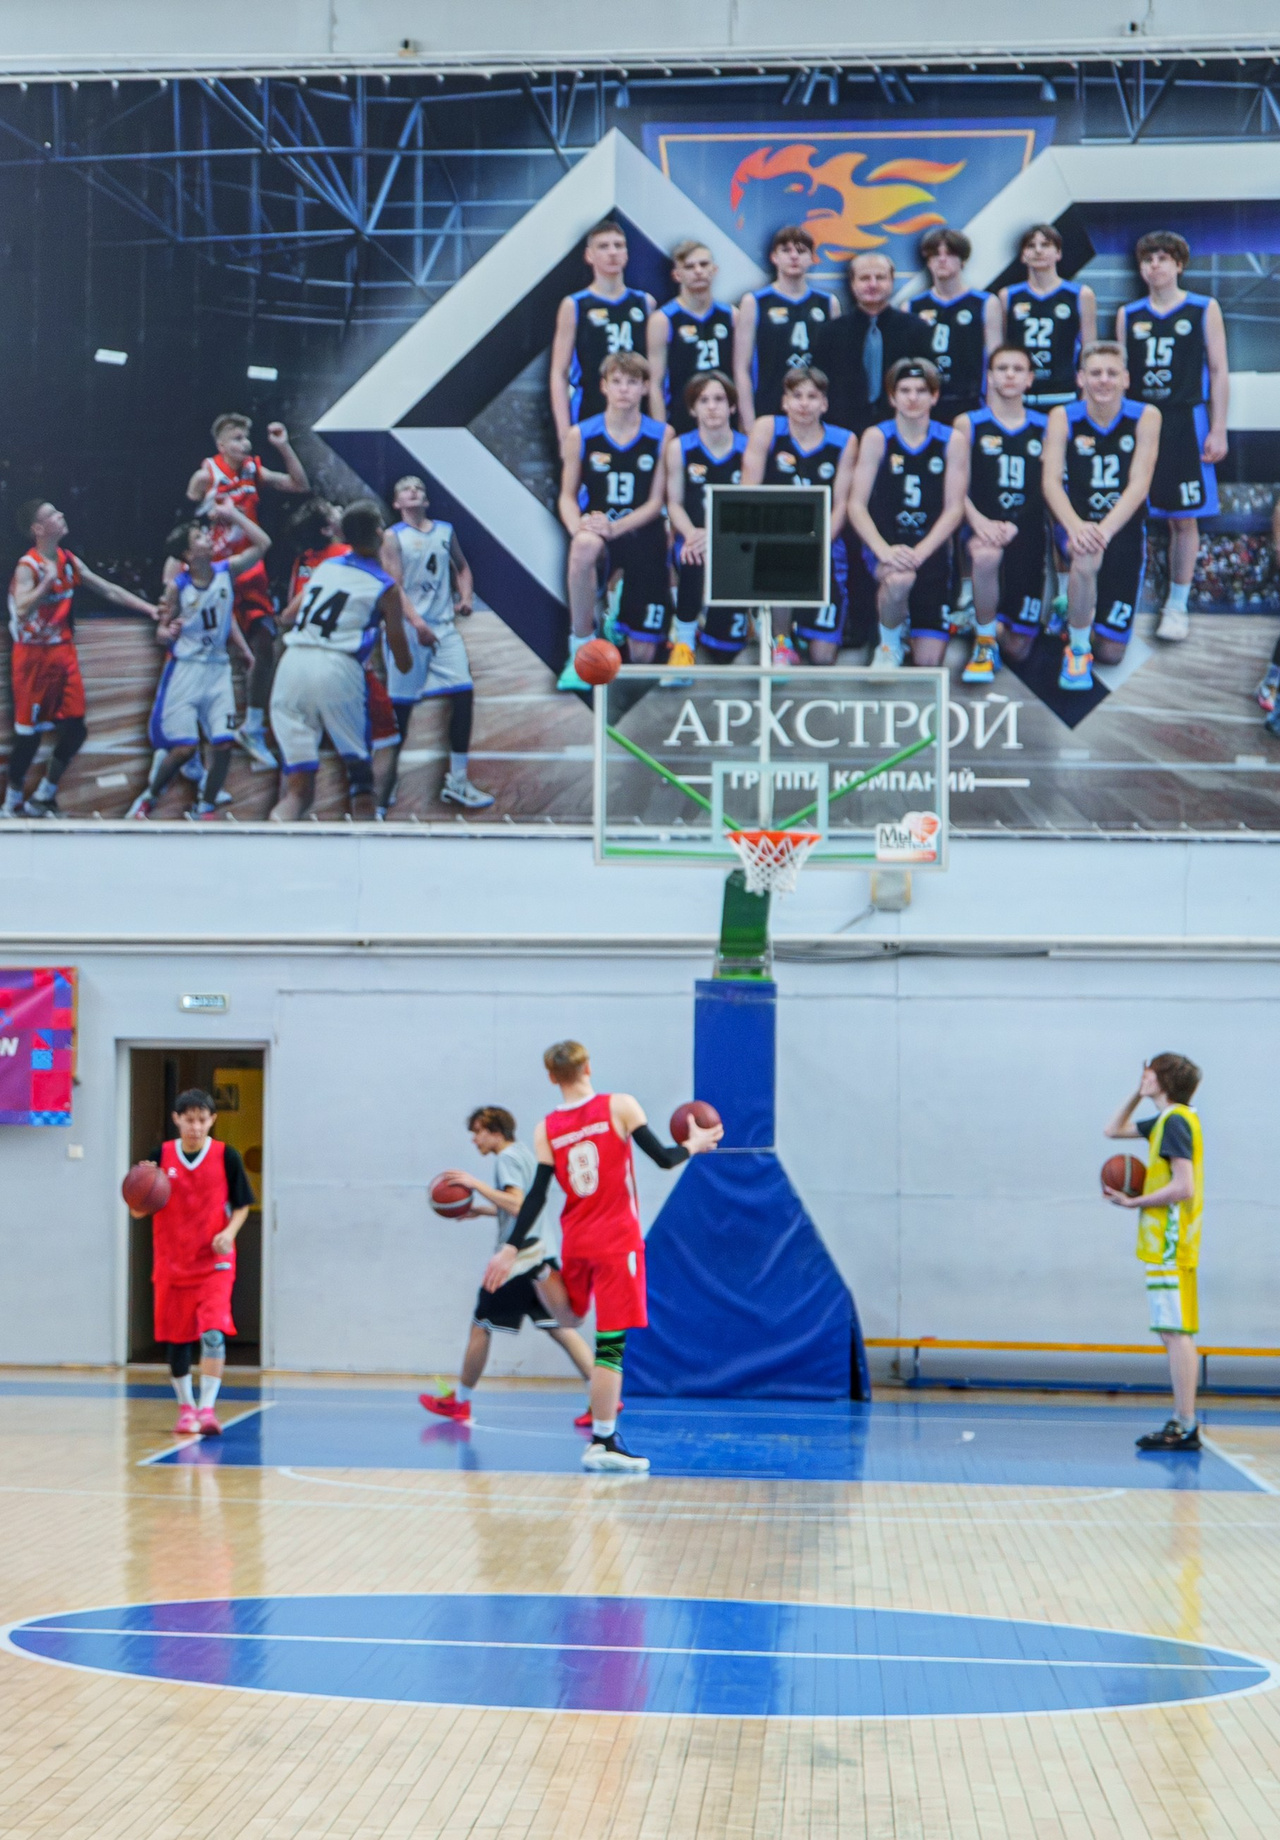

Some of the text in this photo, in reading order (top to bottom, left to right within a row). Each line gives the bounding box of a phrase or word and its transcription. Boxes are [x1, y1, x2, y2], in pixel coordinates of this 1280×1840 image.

[605, 321, 634, 354] 34
[791, 321, 809, 350] 4
[933, 324, 949, 353] 8
[1024, 318, 1053, 348] 22
[696, 338, 719, 371] 23
[1145, 336, 1175, 367] 15
[998, 454, 1025, 490] 19
[1090, 454, 1121, 488] 12
[606, 471, 635, 504] 13
[904, 475, 921, 508] 5
[1179, 482, 1200, 506] 15
[644, 603, 665, 629] 13
[1020, 595, 1040, 621] 19
[1107, 600, 1132, 628] 12
[662, 692, 1025, 750] АРХСТРОЙ
[567, 1141, 600, 1198] 8
